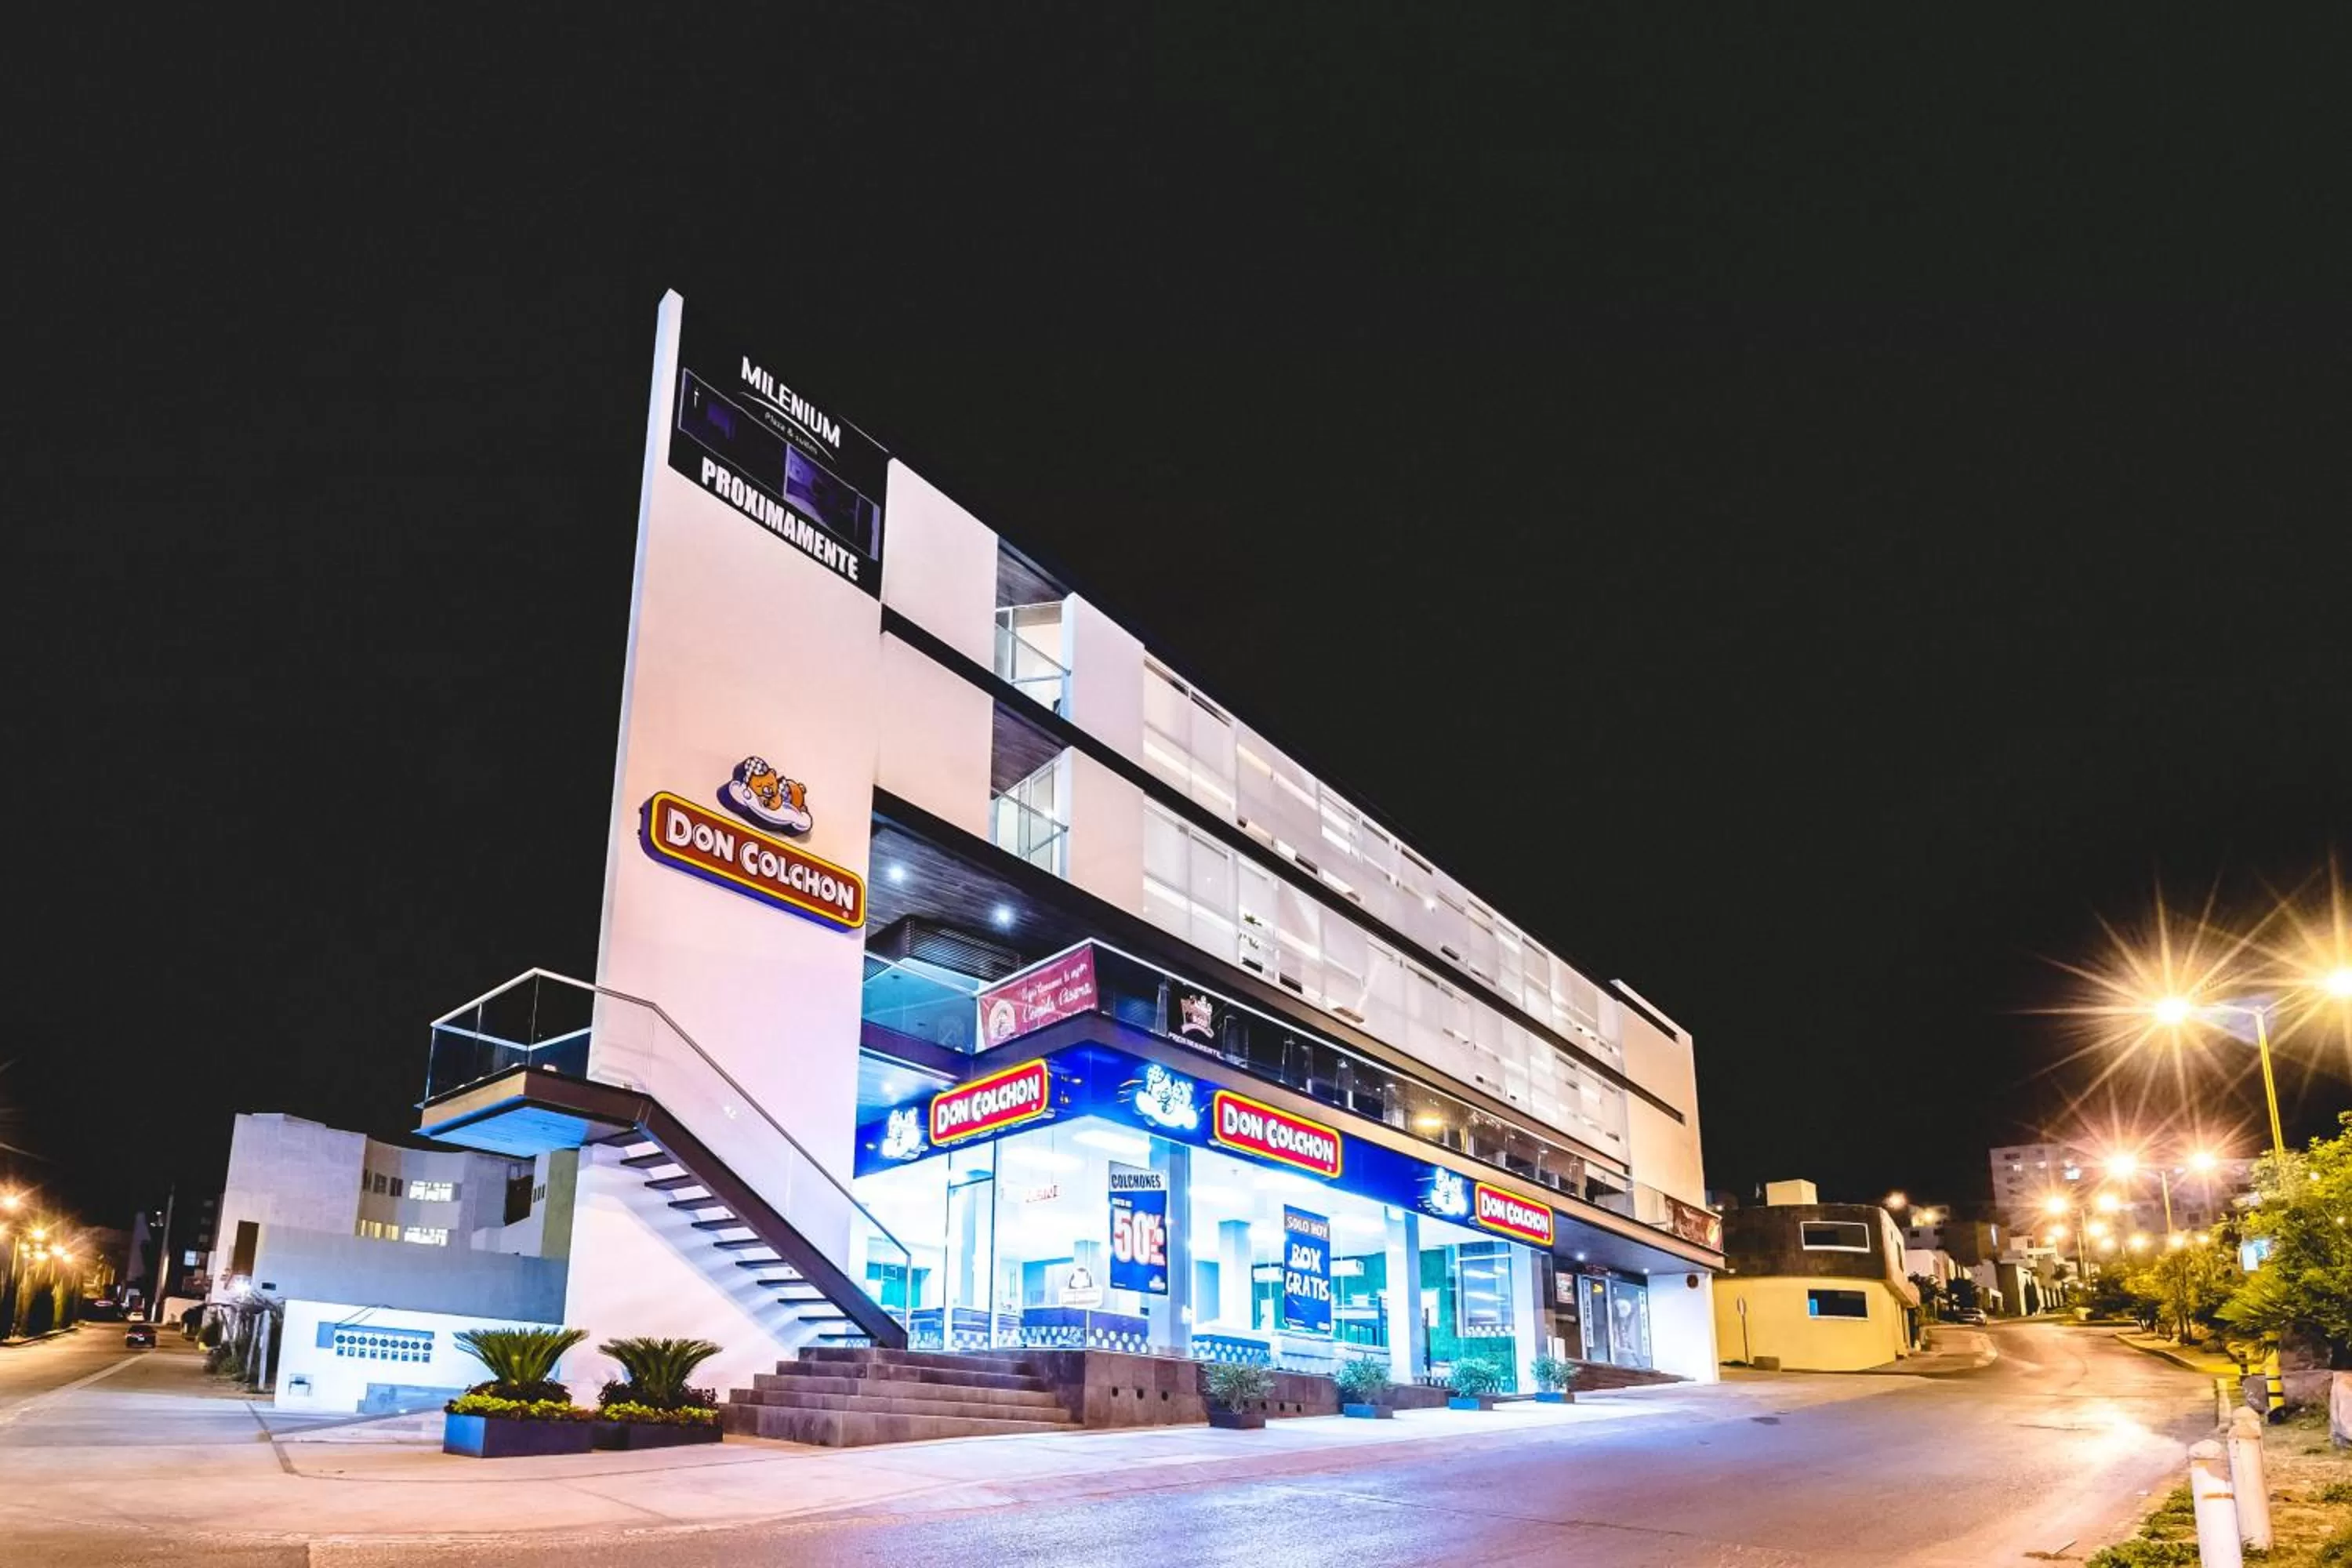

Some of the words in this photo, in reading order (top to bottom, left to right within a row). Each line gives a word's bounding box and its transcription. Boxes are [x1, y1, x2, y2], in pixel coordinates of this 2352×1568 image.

[741, 355, 841, 448] MILENIUM
[701, 456, 858, 581] PROXIMAMENTE
[666, 808, 735, 862] DON
[740, 841, 854, 911] COLCHON
[937, 1098, 969, 1134] DON
[971, 1074, 1040, 1122] COLCHON
[1222, 1102, 1263, 1141] DON
[1266, 1119, 1334, 1163] COLCHON
[1111, 1174, 1161, 1189] COLCHONES
[1287, 1216, 1309, 1232] SOLO
[1480, 1192, 1506, 1220] DON
[1506, 1200, 1549, 1232] COLCHON
[1289, 1243, 1323, 1273] BOX
[1285, 1272, 1330, 1302] GRATIS
